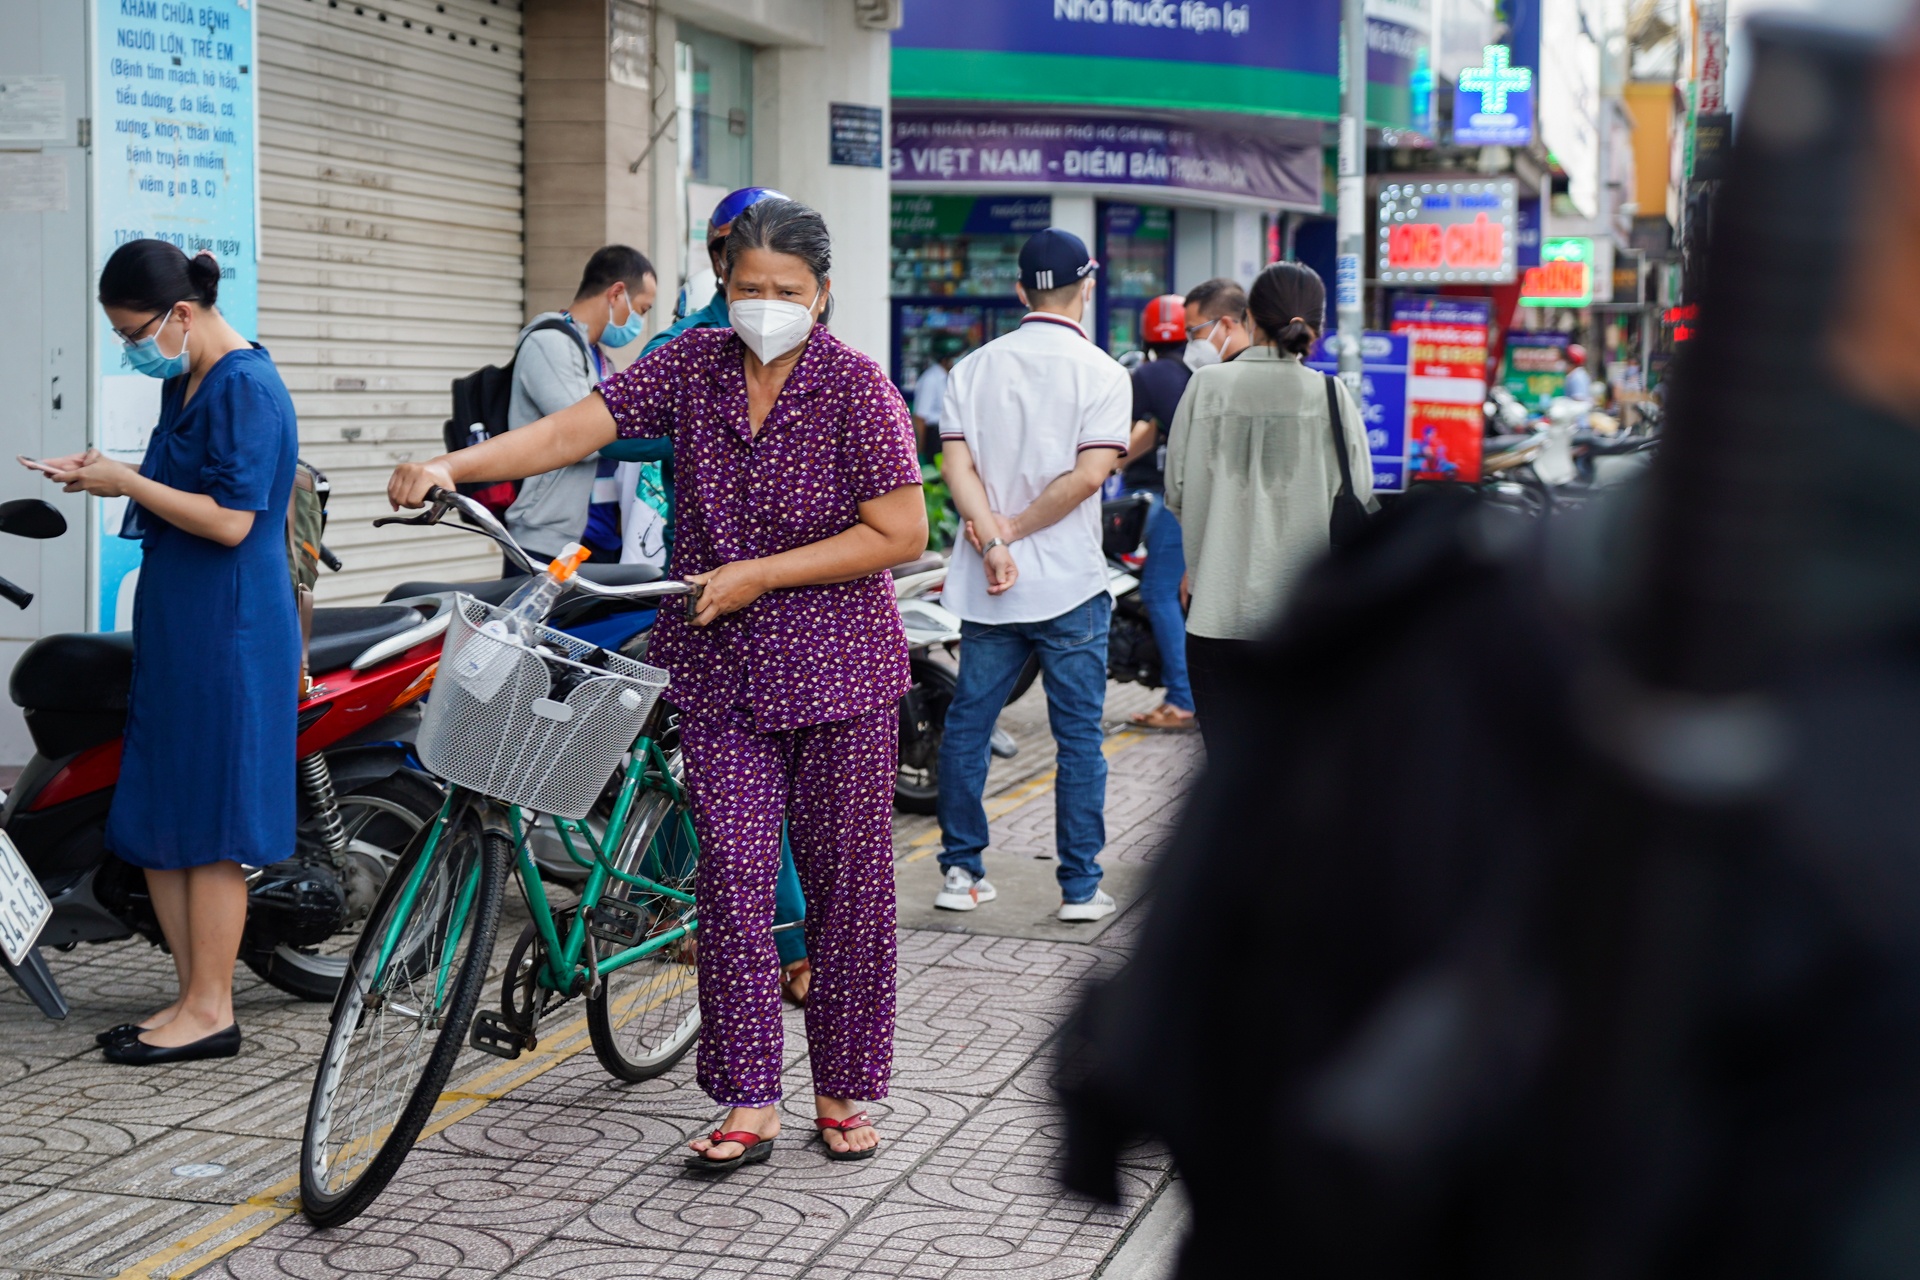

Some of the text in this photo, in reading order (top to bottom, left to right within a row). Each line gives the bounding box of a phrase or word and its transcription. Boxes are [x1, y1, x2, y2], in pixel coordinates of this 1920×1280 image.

[161, 1, 194, 25] CHỮA
[199, 6, 229, 30] BỆNH
[1223, 1, 1250, 37] lợi
[117, 27, 155, 51] NGƯỜI
[217, 42, 233, 61] EM
[110, 57, 143, 79] (Bệnh
[147, 63, 164, 80] tim
[168, 68, 199, 86] mạch,
[909, 145, 974, 179] VIỆT
[979, 146, 1042, 175] NAM
[139, 174, 163, 192] viêm
[205, 179, 216, 199] C)
[217, 237, 240, 256] ngày
